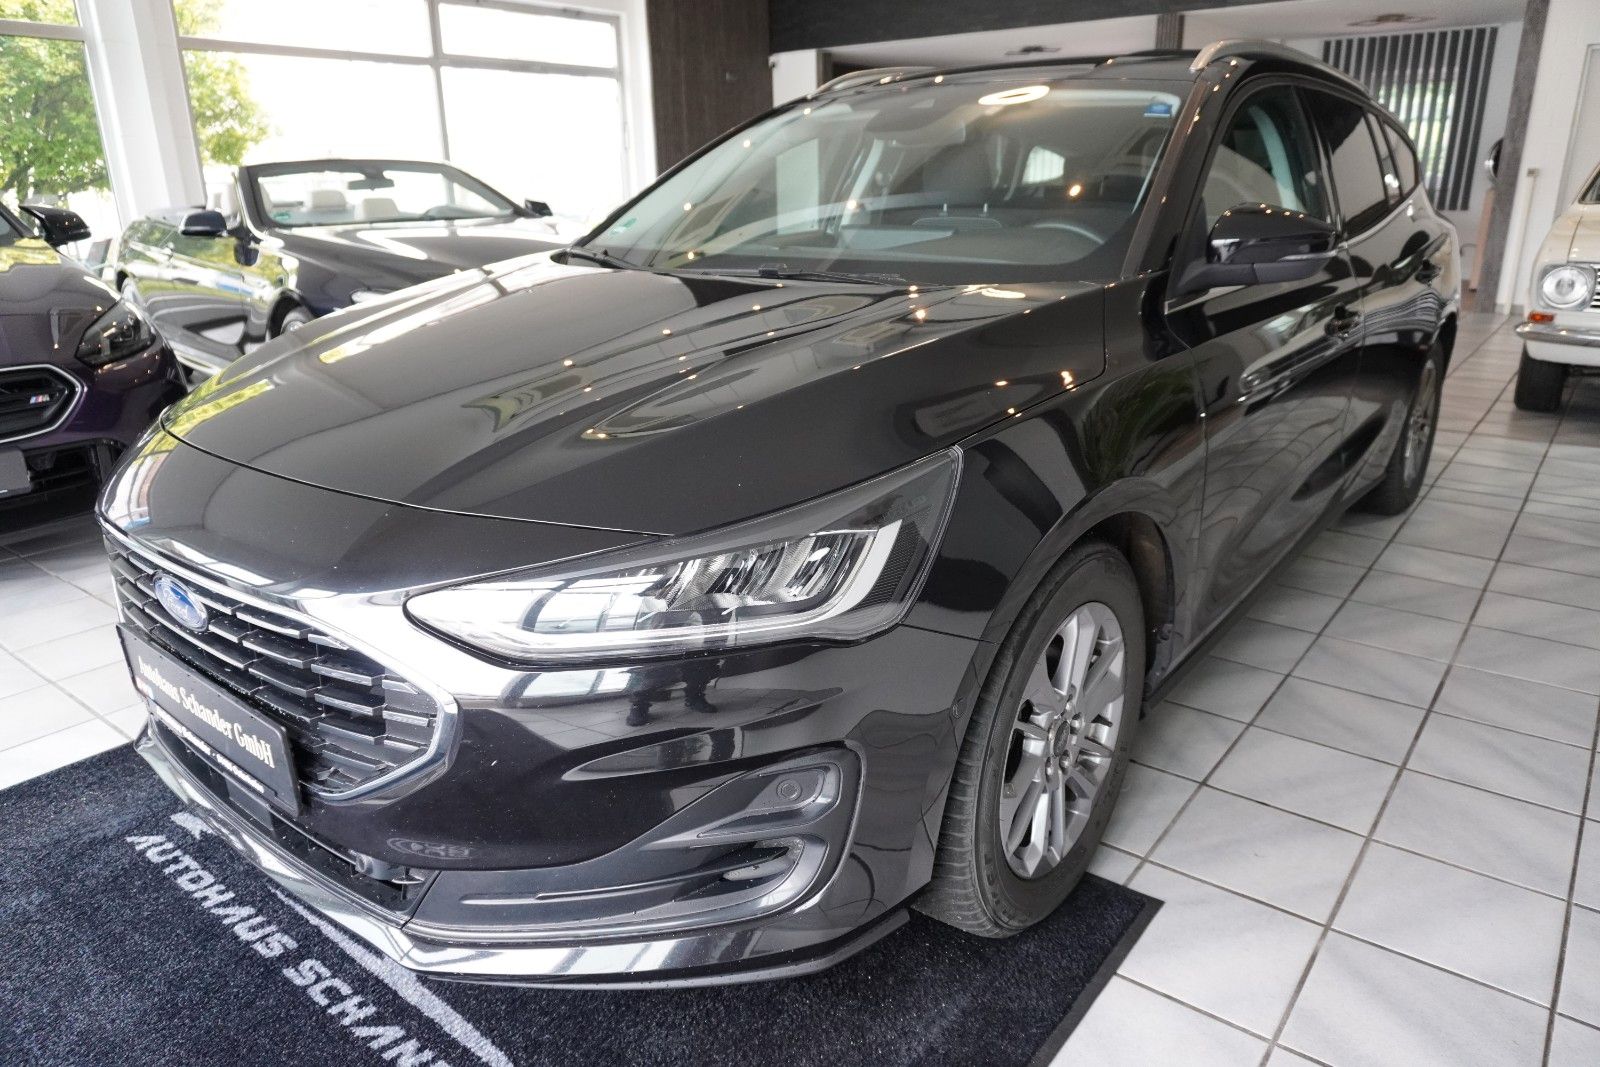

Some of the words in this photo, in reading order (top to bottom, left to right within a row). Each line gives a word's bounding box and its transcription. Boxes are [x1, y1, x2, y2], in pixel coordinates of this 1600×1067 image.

[179, 687, 233, 739] Schander
[233, 722, 275, 768] GmbH
[125, 835, 298, 958] AUTOHAUS
[282, 958, 452, 1067] SCHAN
